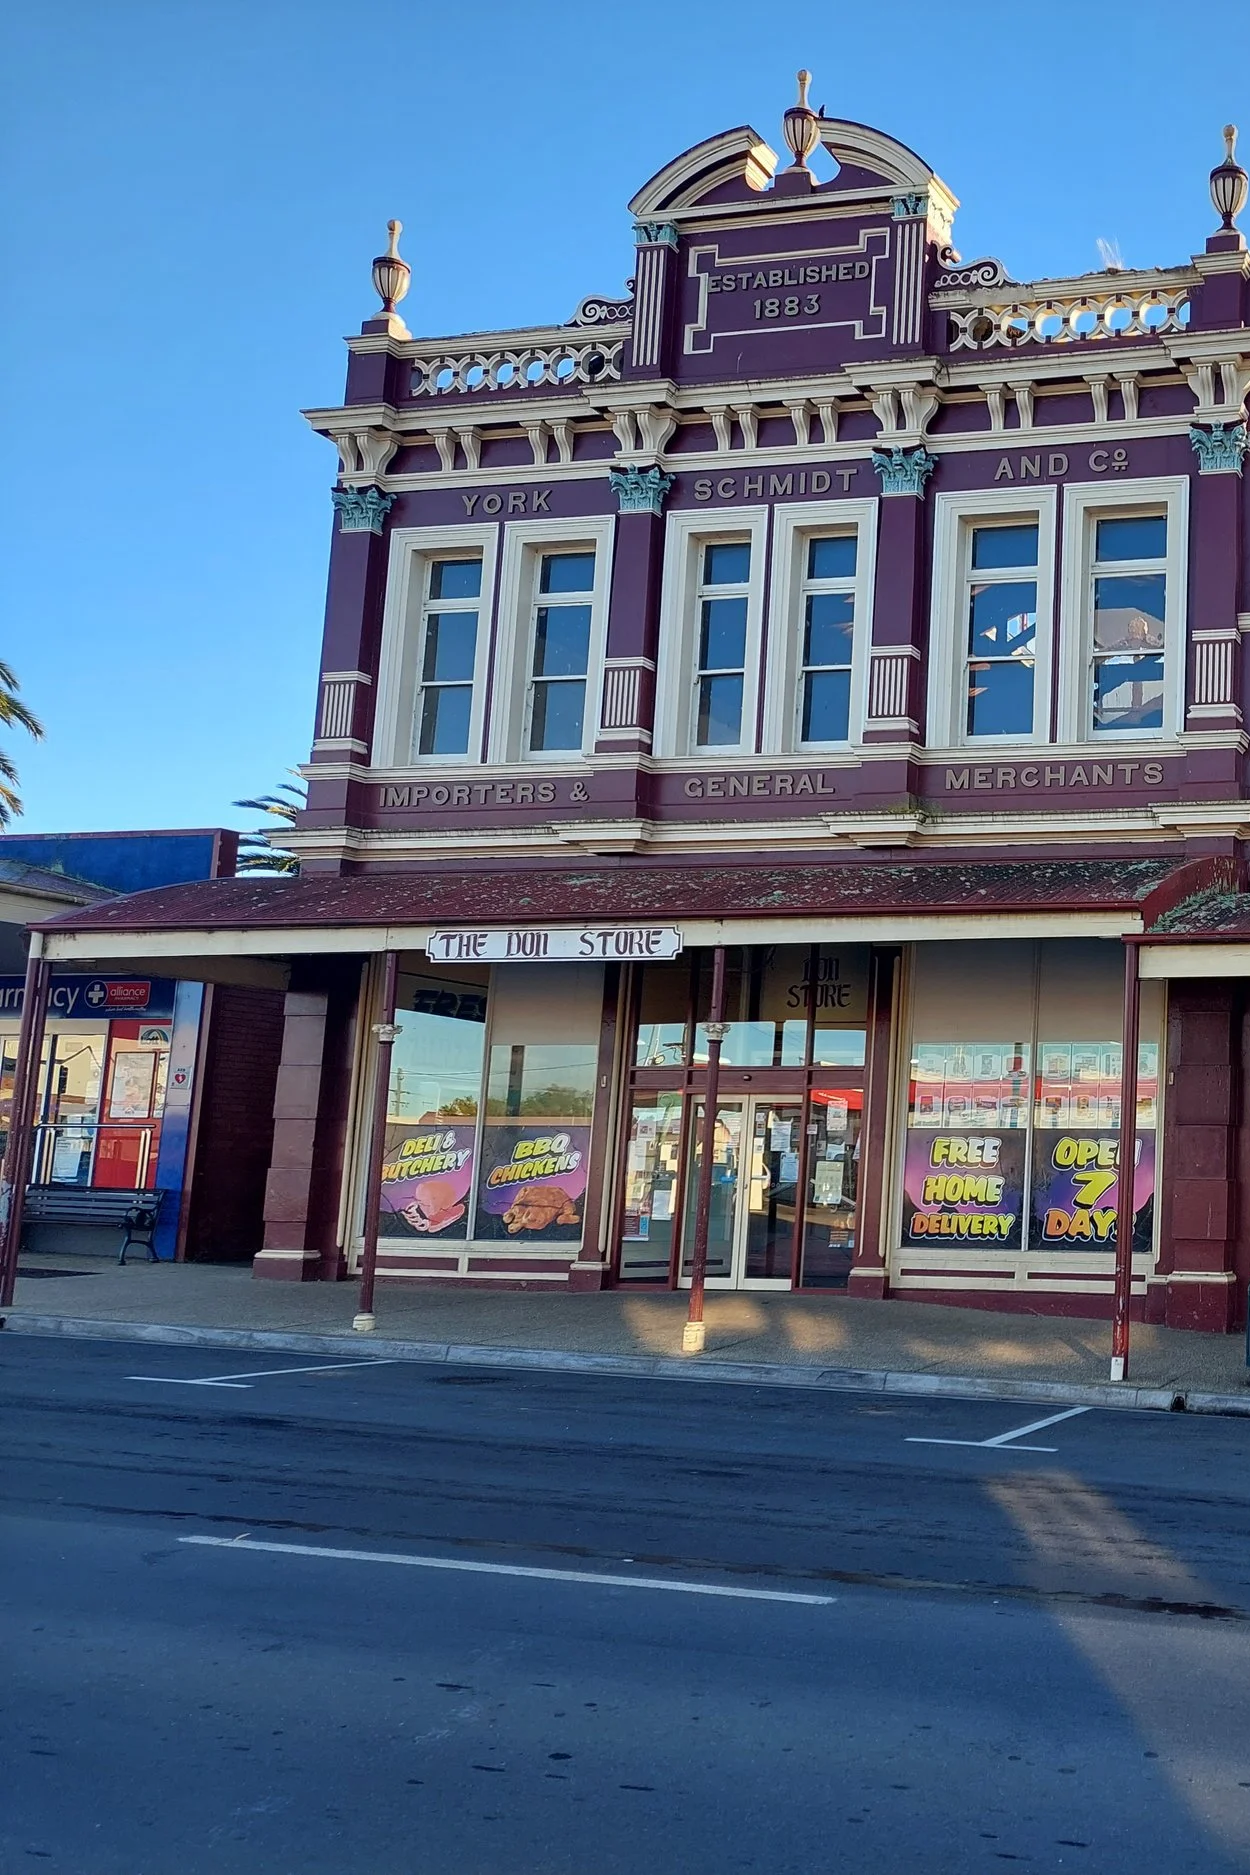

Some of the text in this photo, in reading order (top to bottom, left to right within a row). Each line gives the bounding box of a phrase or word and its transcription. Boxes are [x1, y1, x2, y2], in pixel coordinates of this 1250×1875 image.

[708, 261, 870, 294] ESTABLISHED
[754, 294, 821, 320] 1883
[994, 453, 1069, 481] AND
[694, 468, 858, 501] SCHMIDT
[462, 489, 552, 516] YORK
[684, 773, 836, 799] GENERAL
[945, 762, 1164, 790] MERCHANTS
[379, 781, 589, 808] IMPORTERS &
[438, 932, 487, 960] THE
[578, 929, 663, 956] STORE
[109, 985, 146, 997] alliance
[786, 983, 851, 1008] STORE
[413, 988, 487, 1023] FRE
[401, 1131, 456, 1157] DELI &
[513, 1134, 570, 1160] BBQ
[931, 1137, 1001, 1167] FREE
[489, 1153, 582, 1186] CHICKENS
[923, 1175, 1004, 1205] HOME
[1072, 1171, 1118, 1207] 7
[912, 1213, 1014, 1238] DELIVERY
[1044, 1209, 1136, 1239] DAY
